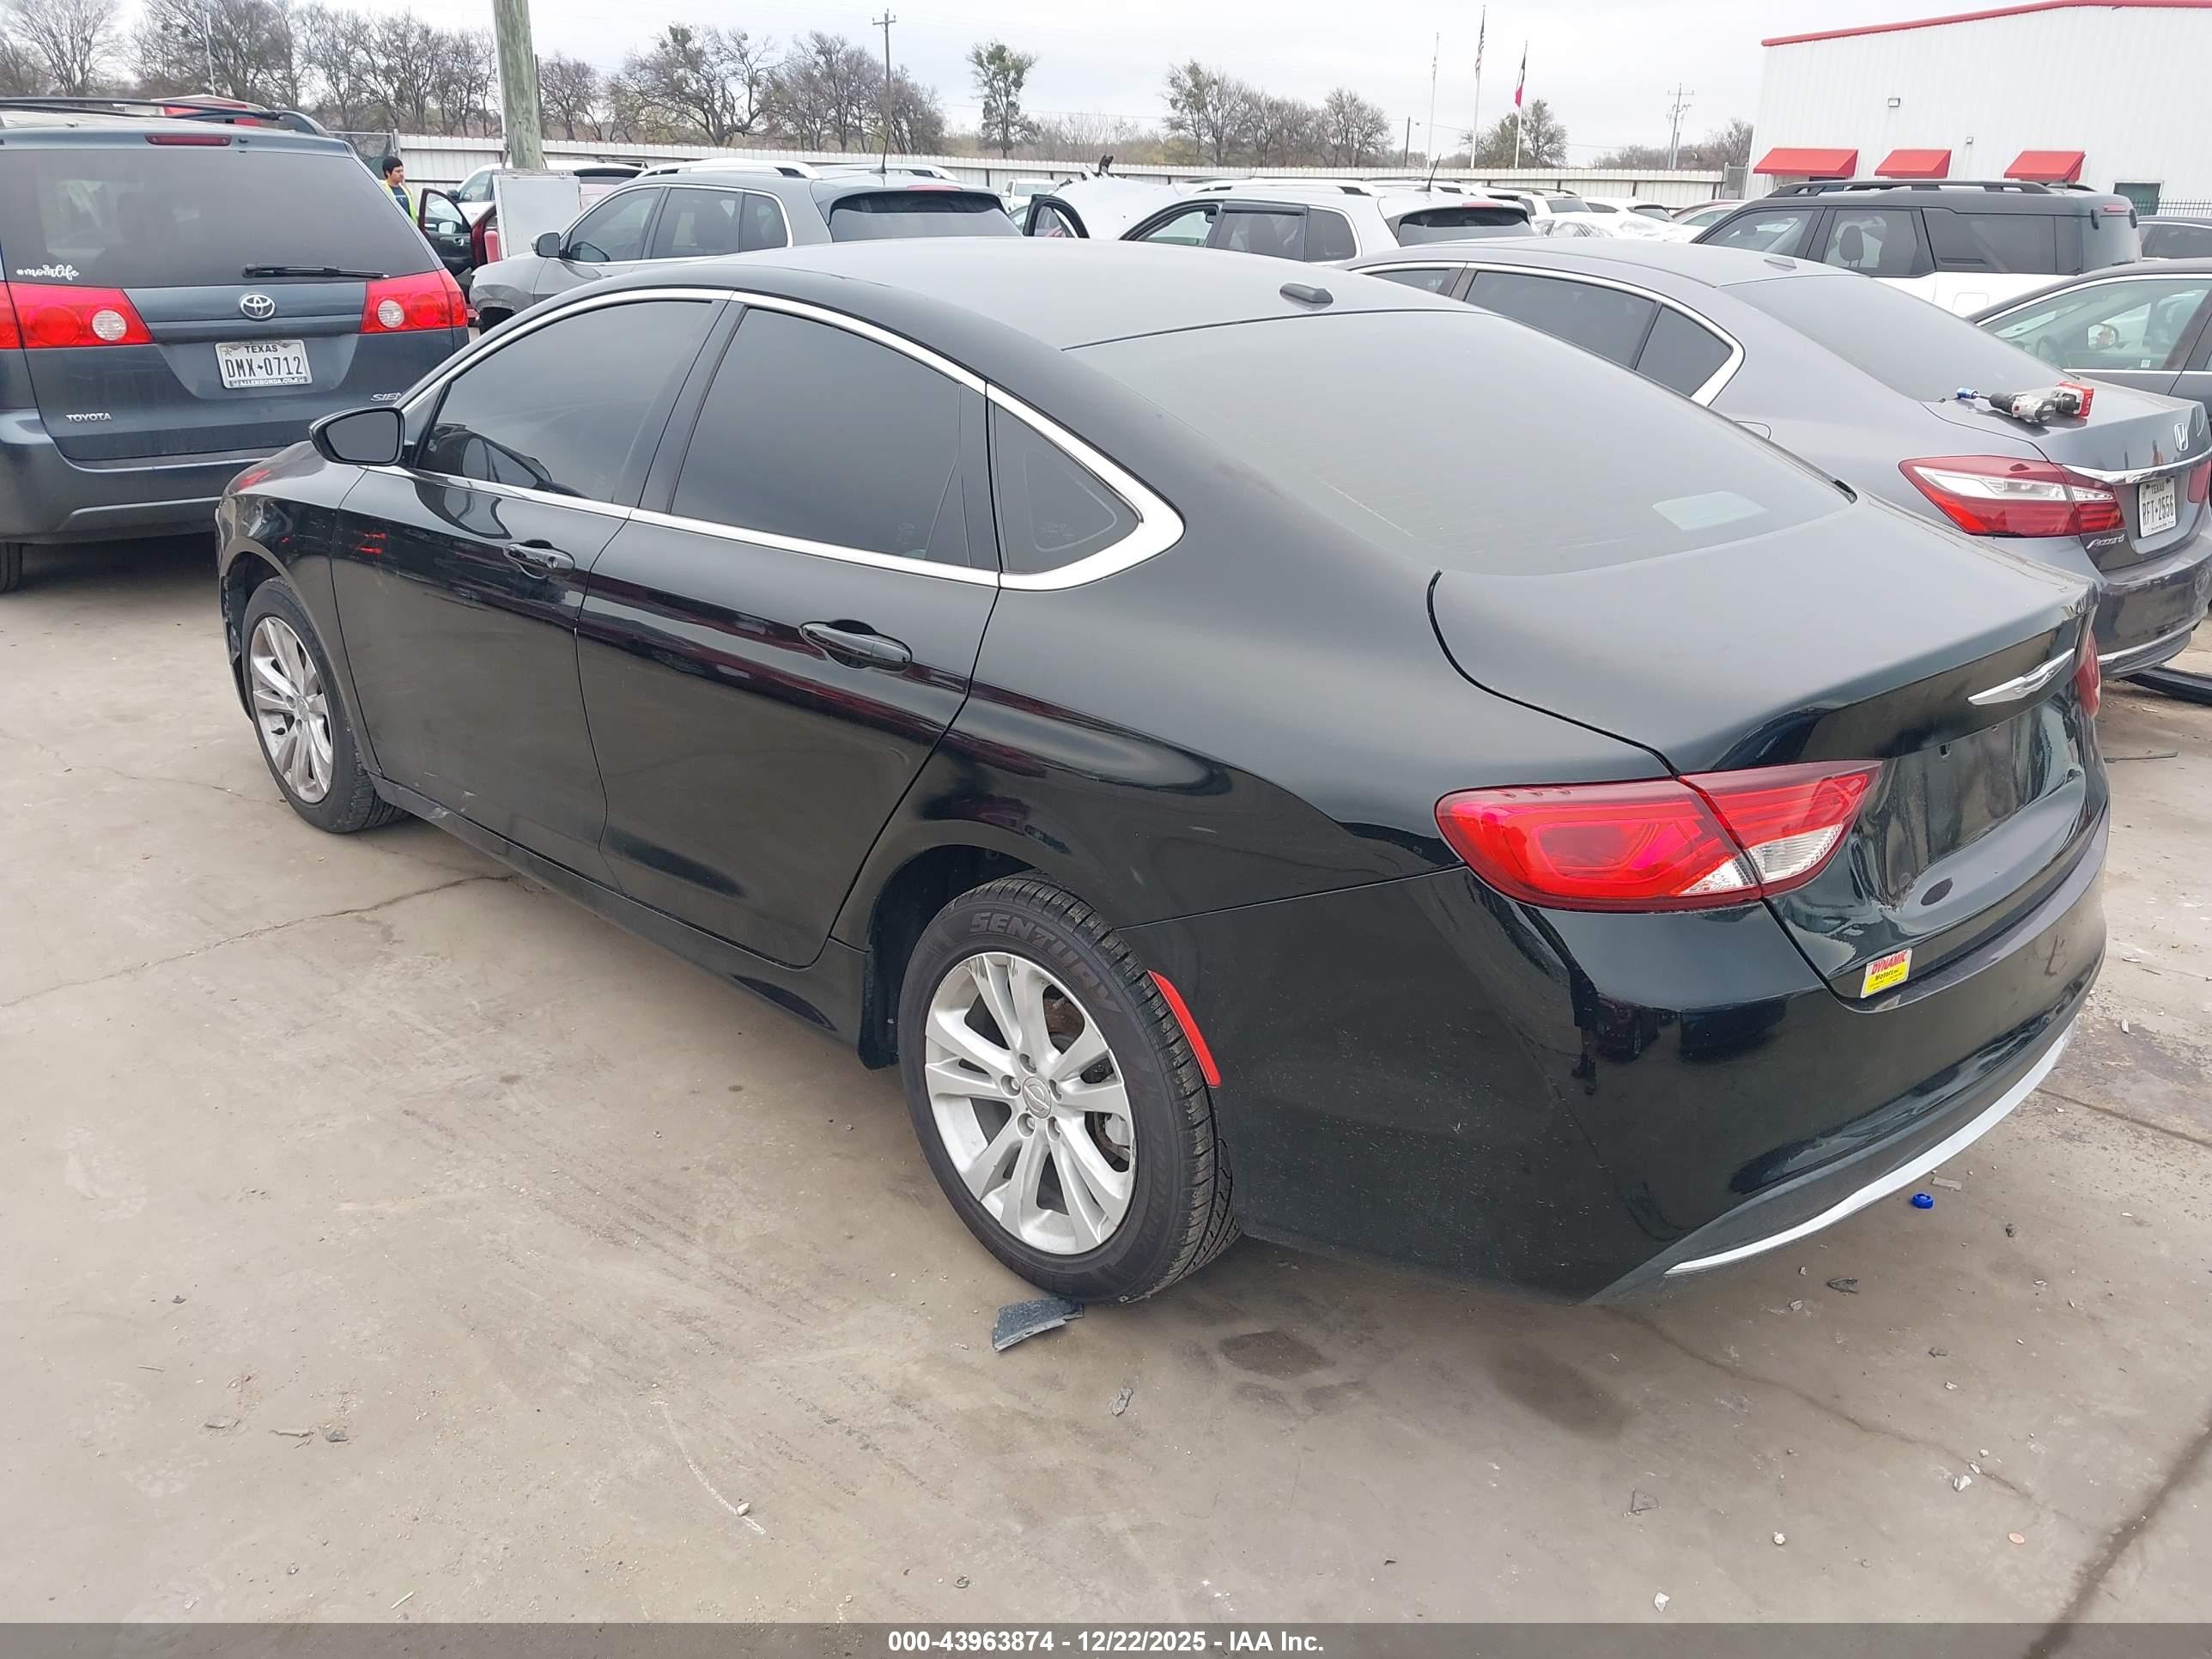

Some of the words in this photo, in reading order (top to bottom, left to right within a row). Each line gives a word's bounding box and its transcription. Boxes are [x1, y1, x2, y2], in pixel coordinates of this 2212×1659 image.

[244, 344, 278, 354] TEXAS
[65, 412, 112, 422] TOYOTA
[969, 911, 1124, 1014] SENTURY
